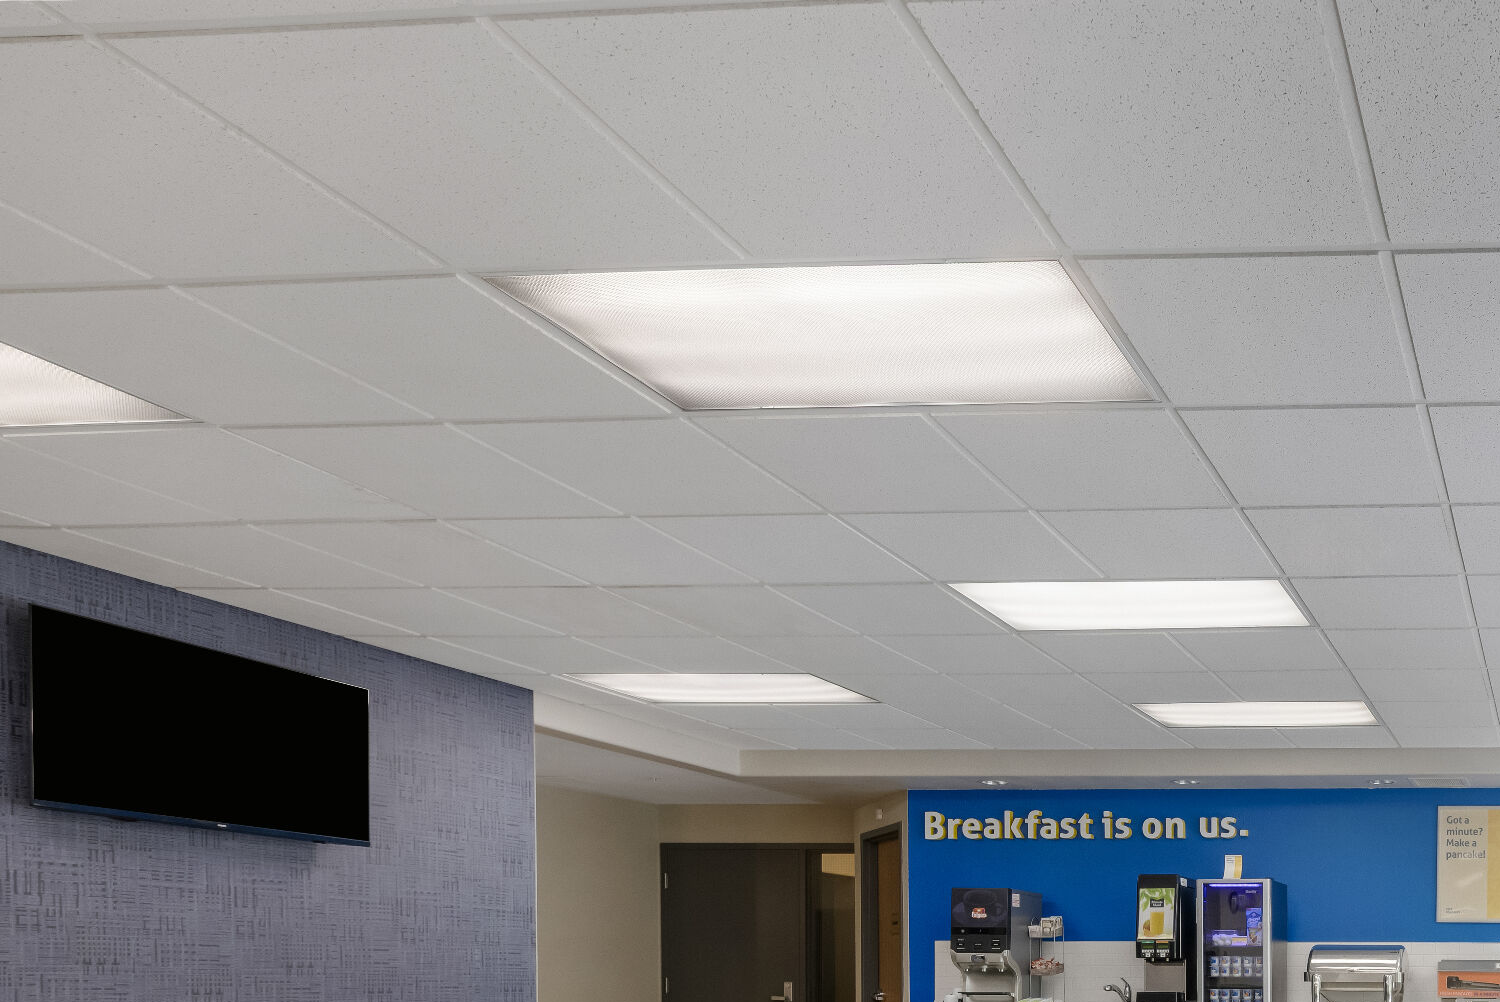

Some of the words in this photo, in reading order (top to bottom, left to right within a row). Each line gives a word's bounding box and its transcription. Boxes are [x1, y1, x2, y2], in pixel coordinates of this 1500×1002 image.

[1446, 815, 1463, 825] Got
[1464, 817, 1470, 825] a
[924, 810, 1095, 841] Breakfast
[1101, 810, 1133, 840] is
[1141, 816, 1187, 840] on
[1199, 816, 1250, 840] us.
[1446, 827, 1484, 836] minute?
[1446, 838, 1470, 847] Make
[1471, 840, 1477, 848] a
[1446, 850, 1486, 860] pancake!
